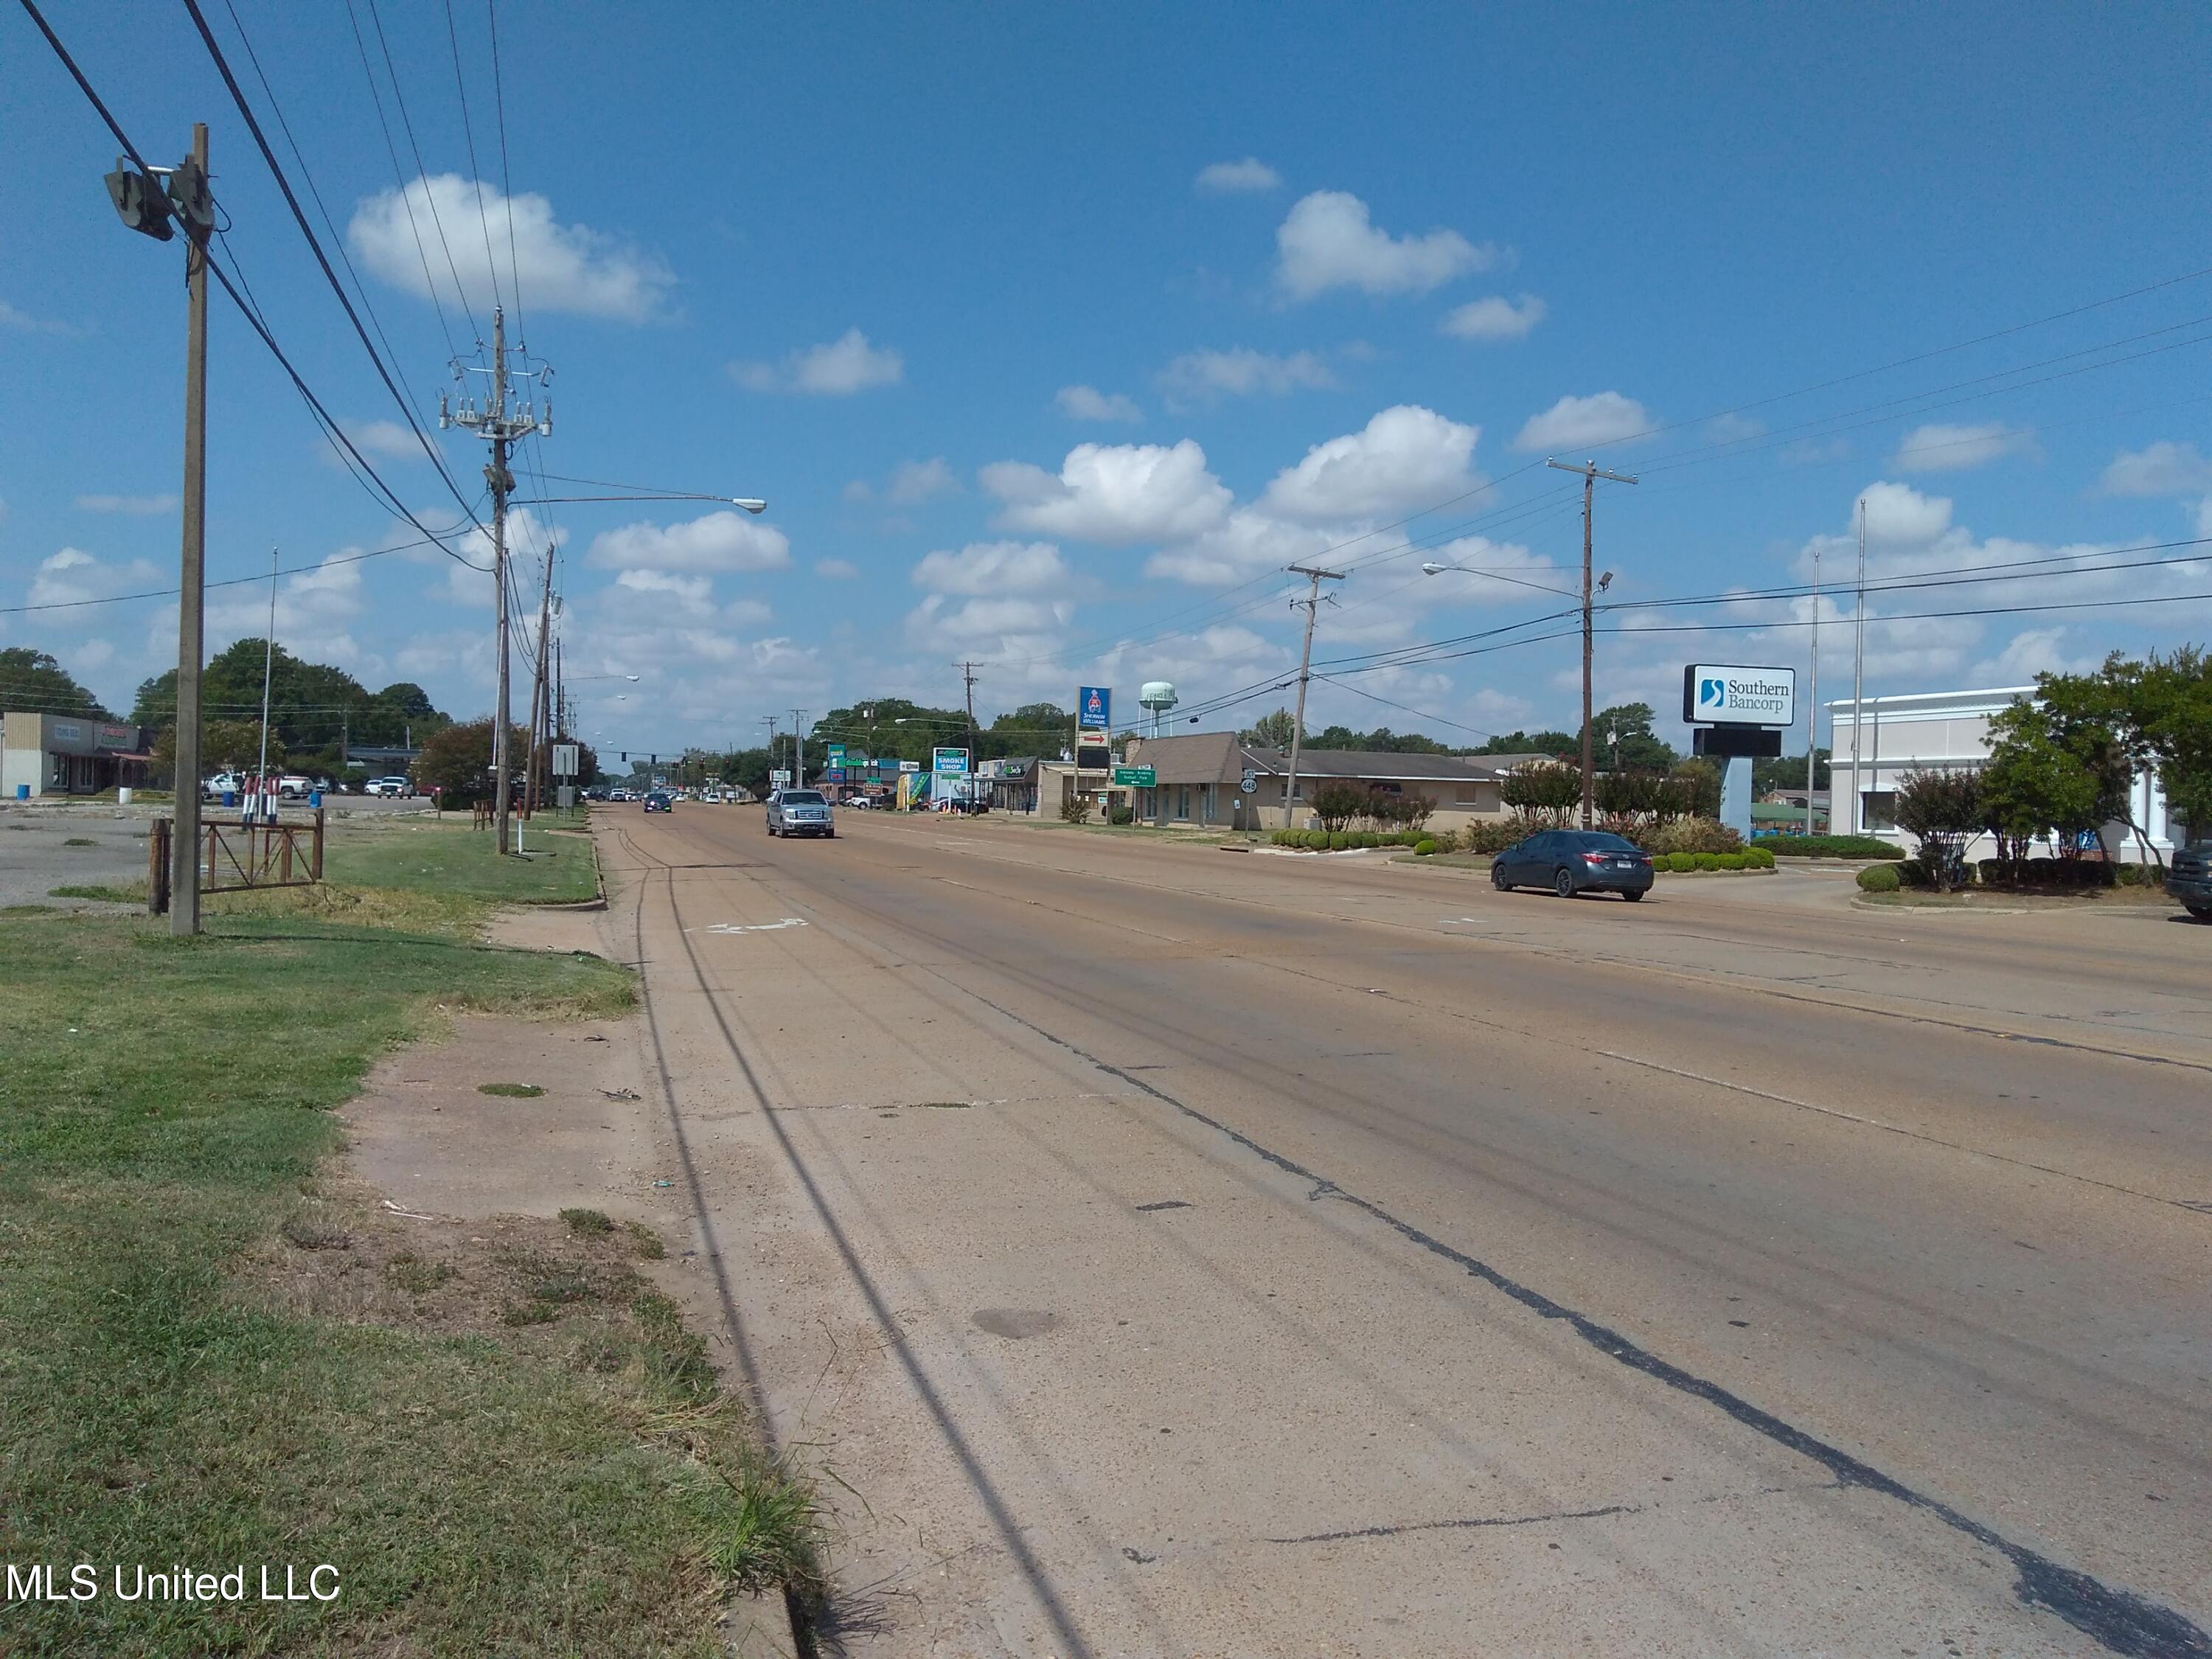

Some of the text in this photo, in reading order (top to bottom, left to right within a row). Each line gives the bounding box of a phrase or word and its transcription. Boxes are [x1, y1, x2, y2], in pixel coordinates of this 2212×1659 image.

[1728, 680, 1789, 696] Southern
[1728, 695, 1784, 714] Bancorp
[1242, 782, 1256, 790] 448
